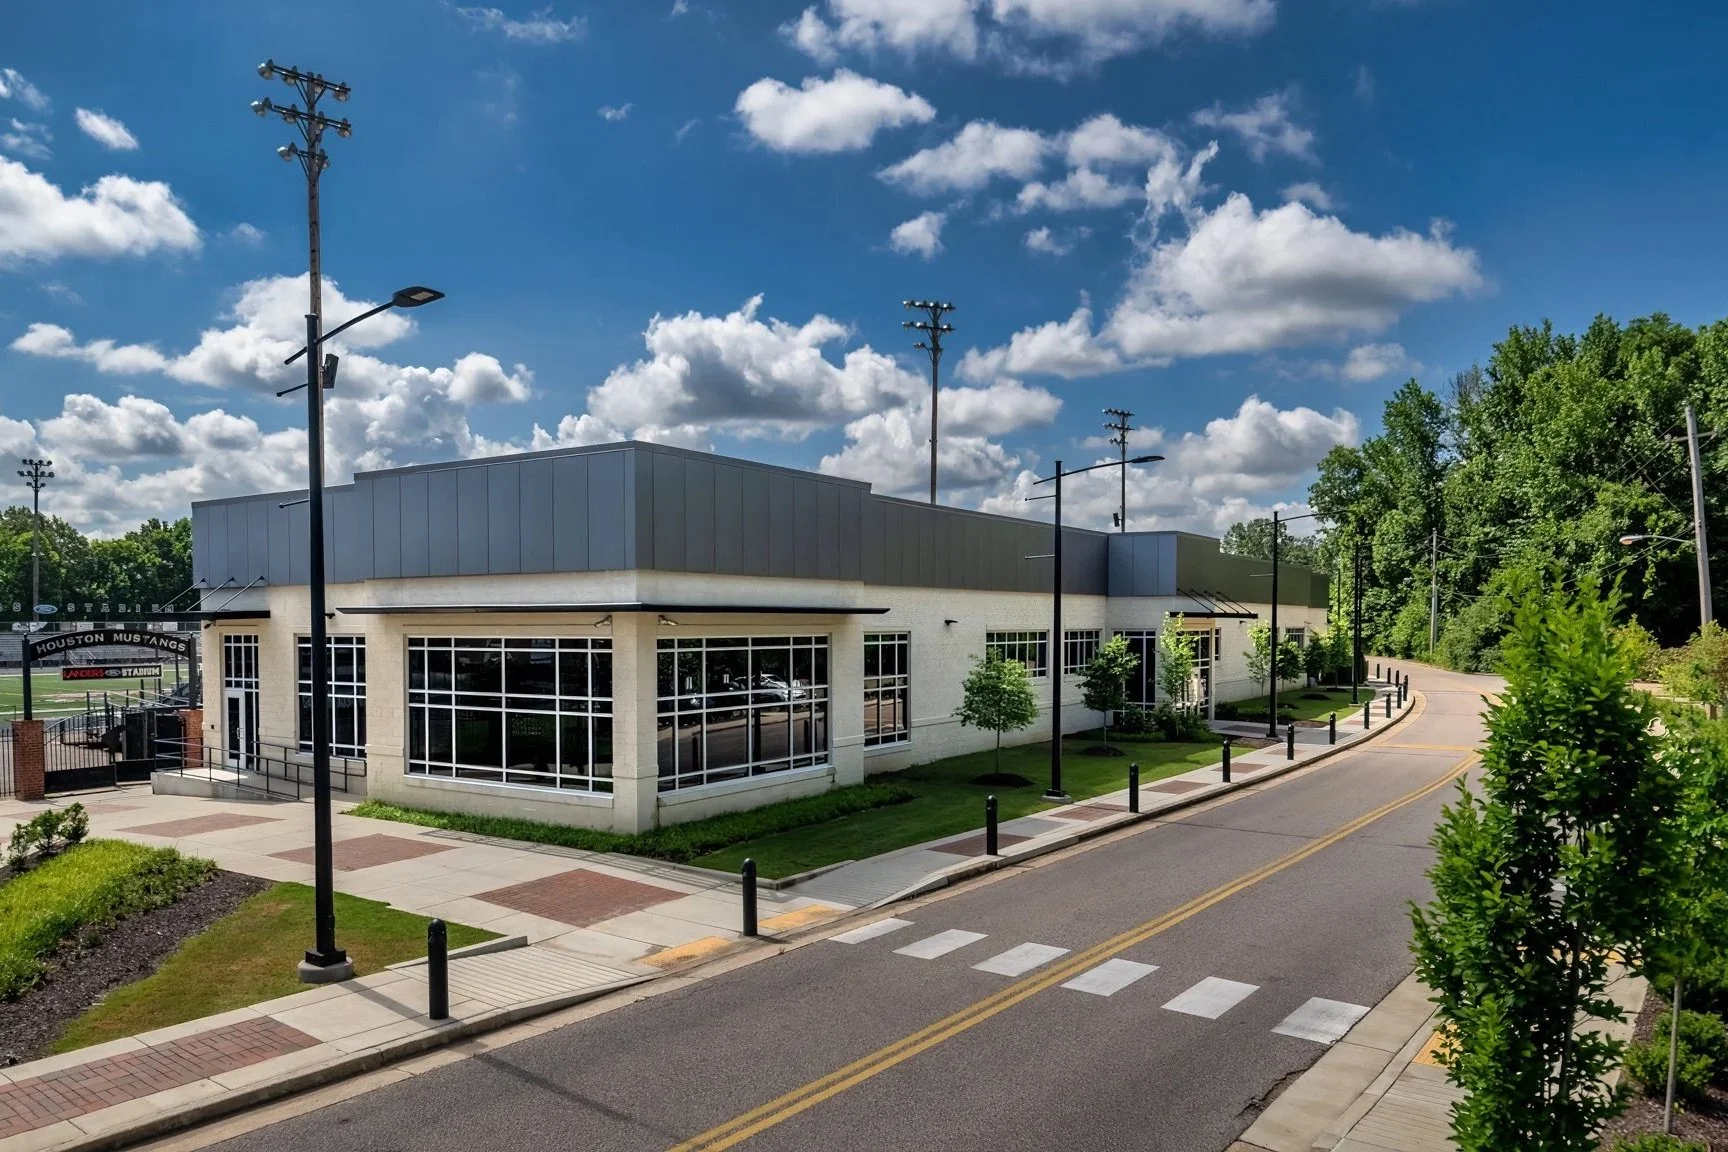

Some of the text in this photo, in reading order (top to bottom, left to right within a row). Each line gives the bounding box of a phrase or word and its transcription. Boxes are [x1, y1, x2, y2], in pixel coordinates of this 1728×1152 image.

[36, 633, 186, 654] HOUSTON MUSTANGS
[121, 667, 159, 677] STADIUM
